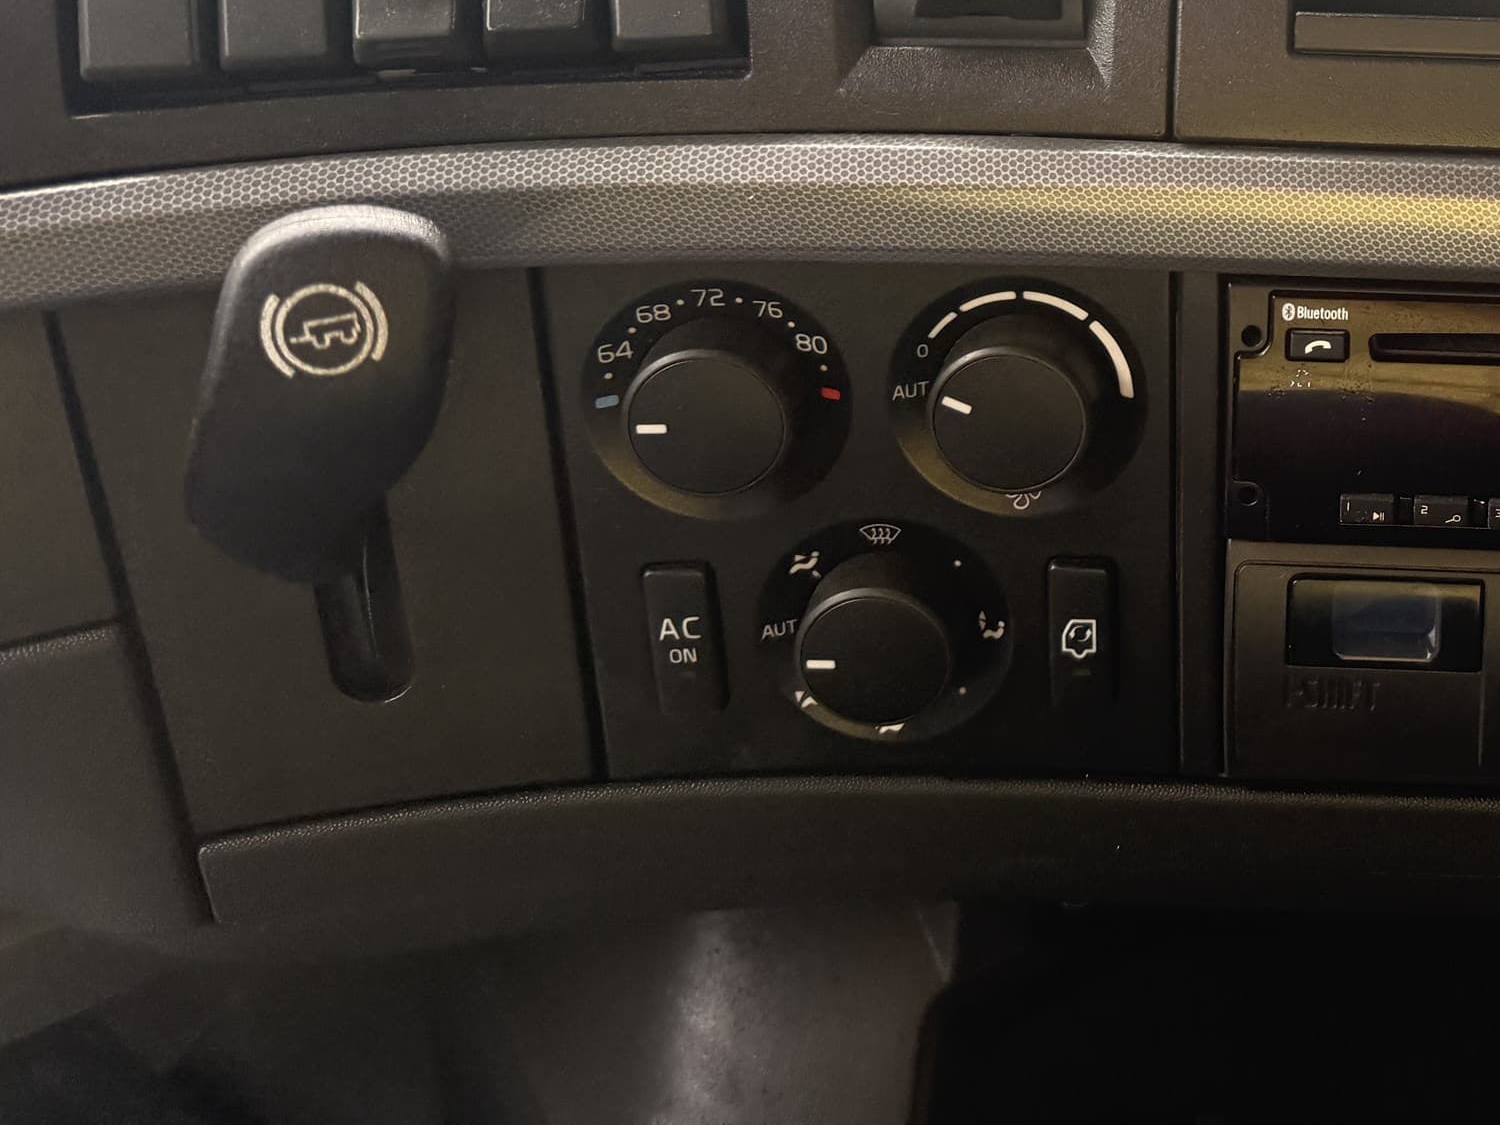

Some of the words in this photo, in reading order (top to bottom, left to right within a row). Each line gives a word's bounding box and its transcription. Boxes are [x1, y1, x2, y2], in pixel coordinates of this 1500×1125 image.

[690, 288, 726, 307] 72
[635, 303, 672, 324] 68
[752, 300, 783, 319] 76
[1296, 305, 1349, 321] Bluetooth
[597, 340, 634, 364] 64
[795, 333, 828, 355] 80
[892, 380, 929, 401] AUT
[1420, 504, 1429, 515] 2
[659, 616, 701, 641] AC
[761, 618, 797, 640] AUT
[669, 648, 697, 664] ON
